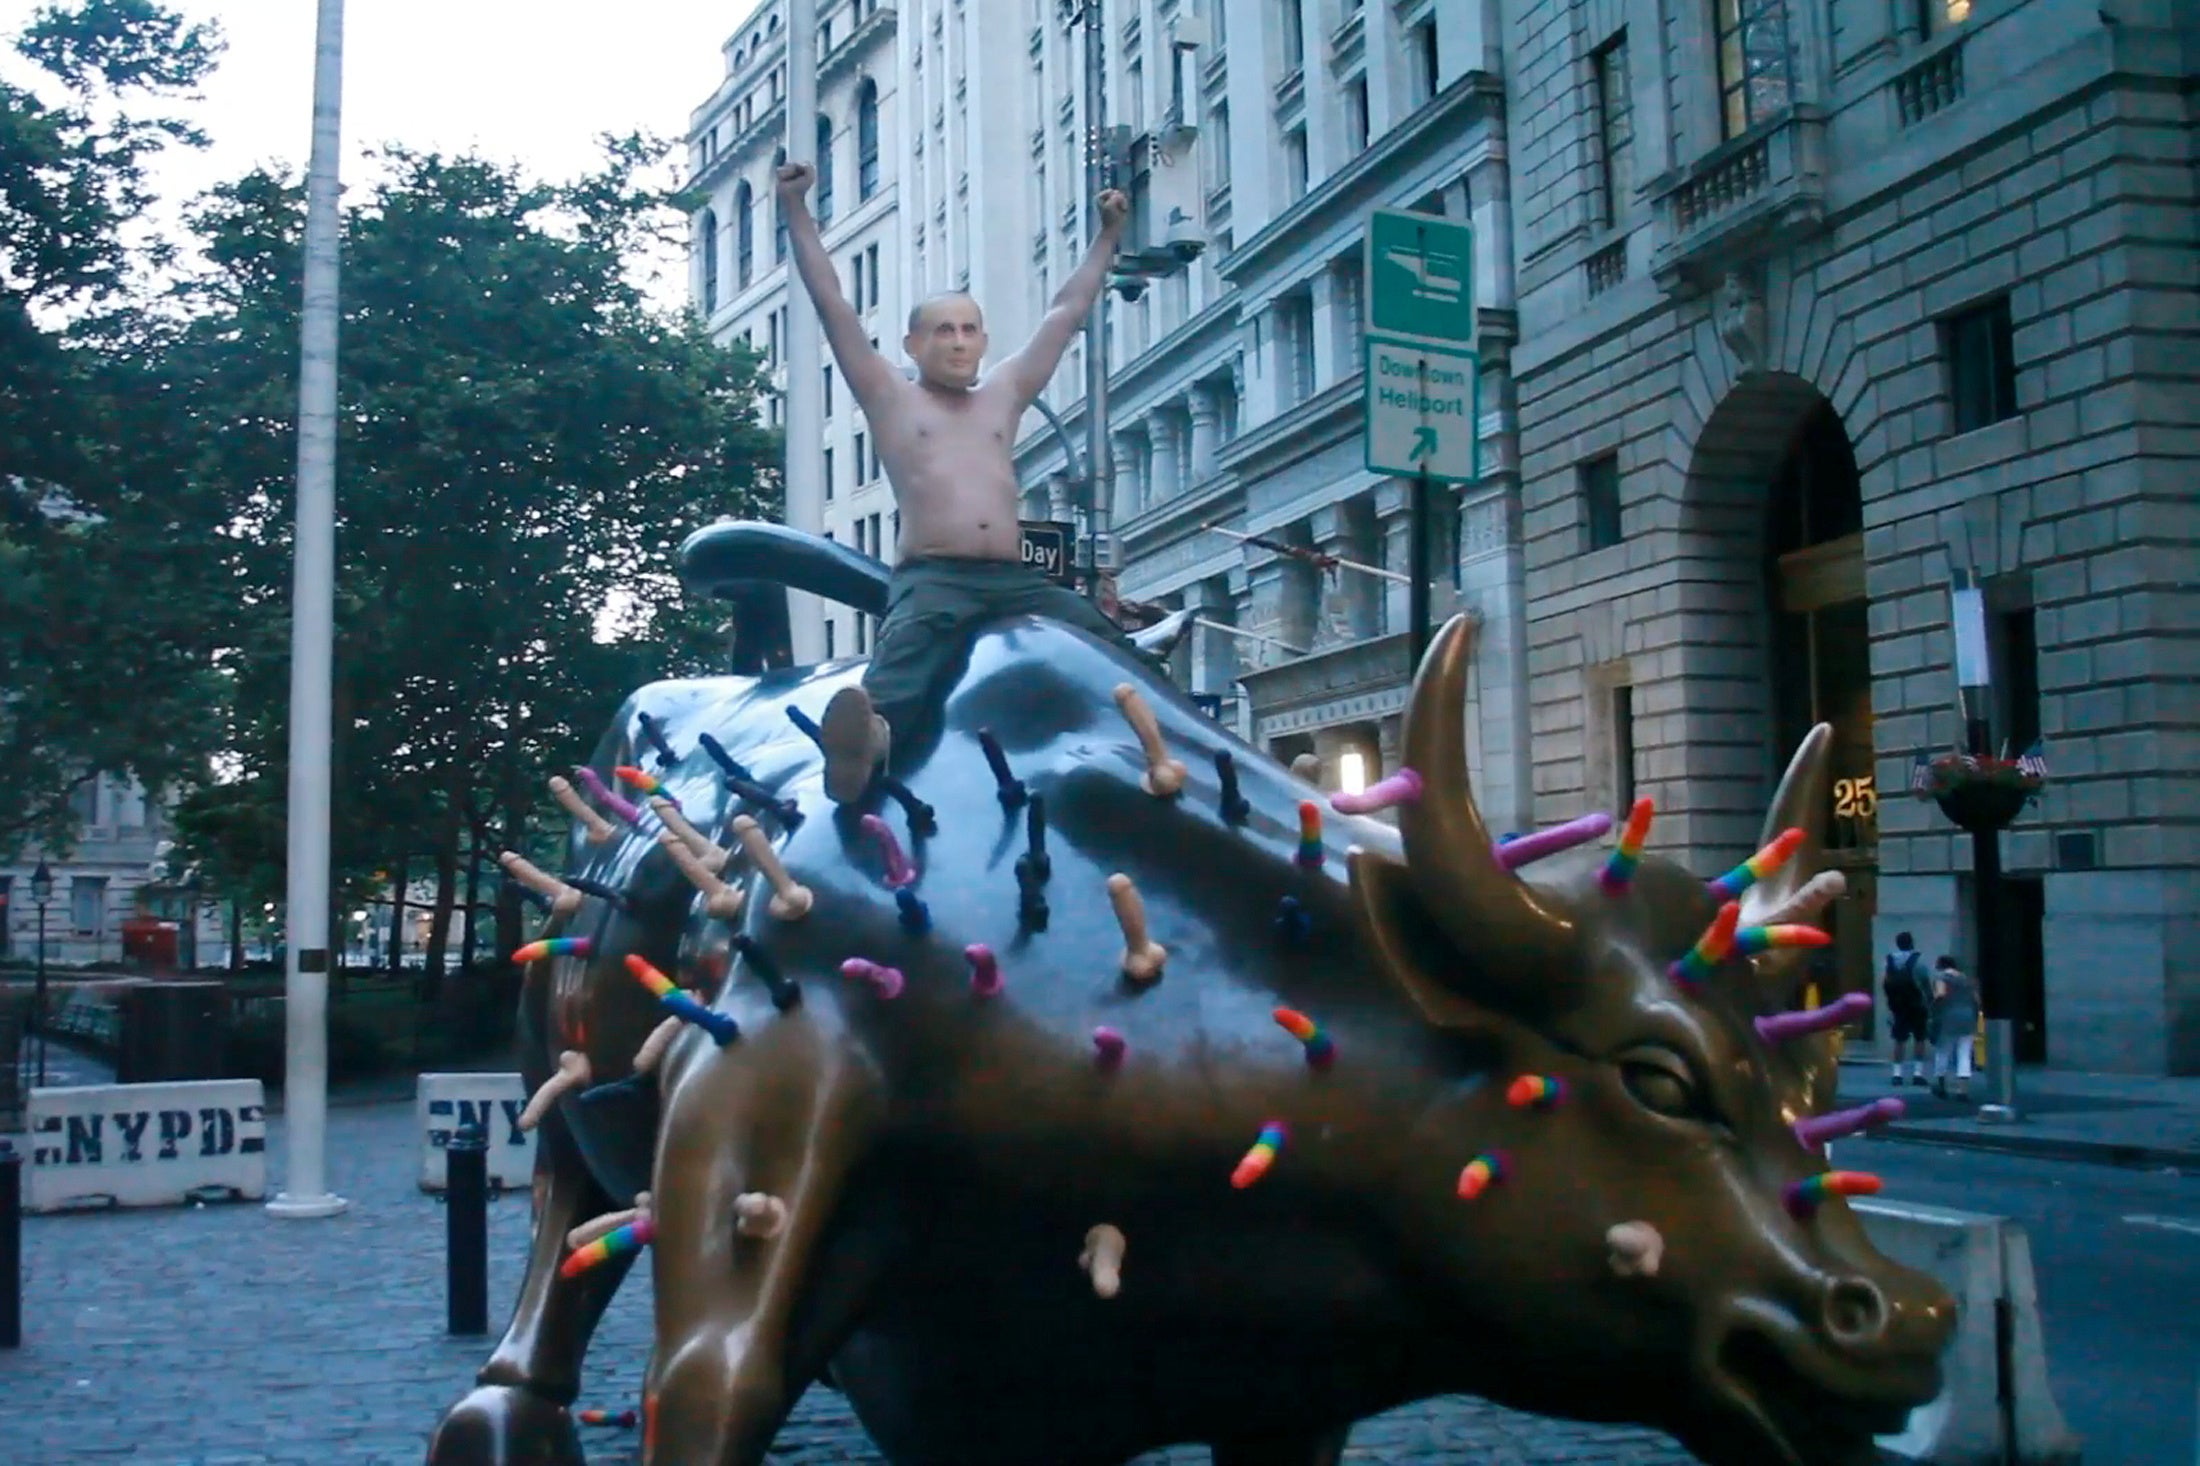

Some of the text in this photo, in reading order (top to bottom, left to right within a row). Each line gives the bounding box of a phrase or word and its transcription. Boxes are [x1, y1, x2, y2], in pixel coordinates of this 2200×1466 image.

[1380, 387, 1462, 416] Heliport
[1021, 539, 1057, 569] Day
[1834, 776, 1876, 816] 25
[67, 1109, 235, 1164] NYPD
